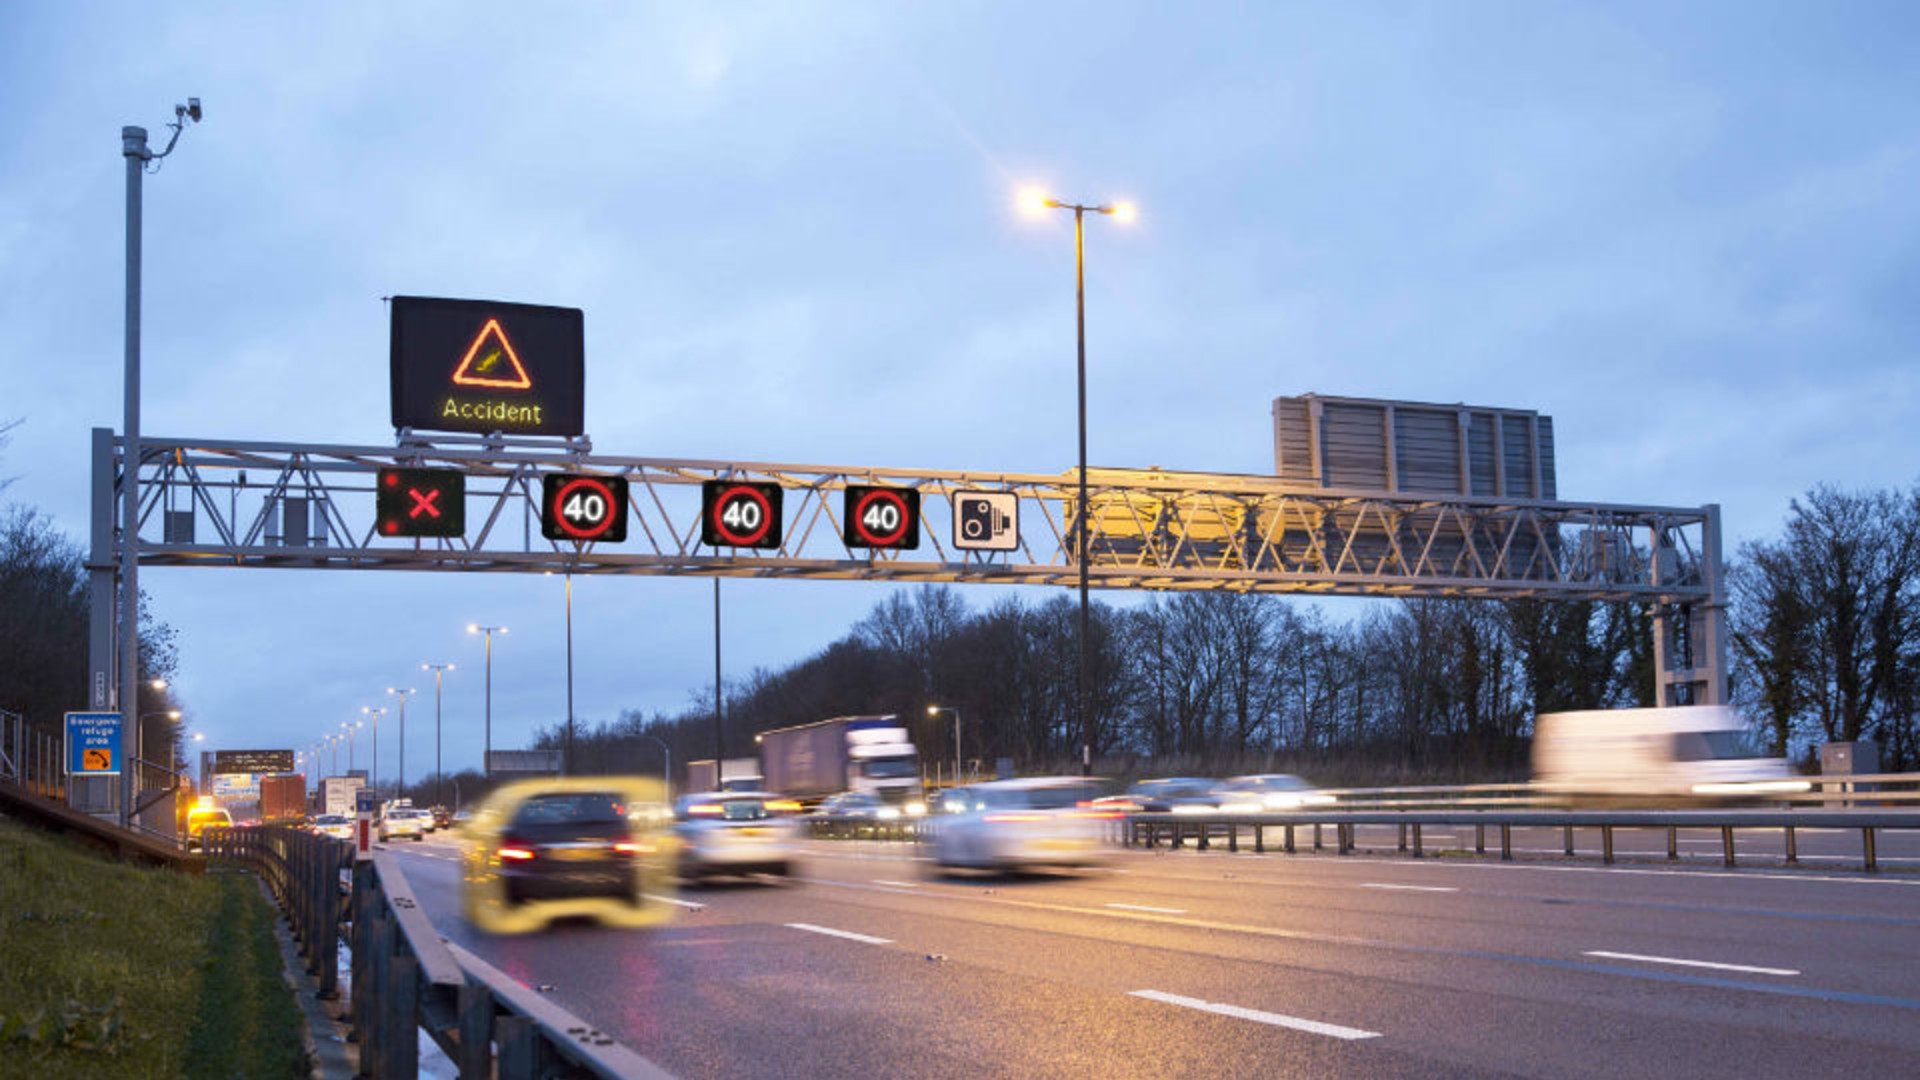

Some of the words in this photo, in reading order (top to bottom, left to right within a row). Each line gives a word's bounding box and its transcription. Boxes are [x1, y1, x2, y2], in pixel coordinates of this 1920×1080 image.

[443, 398, 542, 425] Accident
[563, 493, 604, 521] 40
[723, 501, 760, 529] 40
[863, 504, 899, 530] 40
